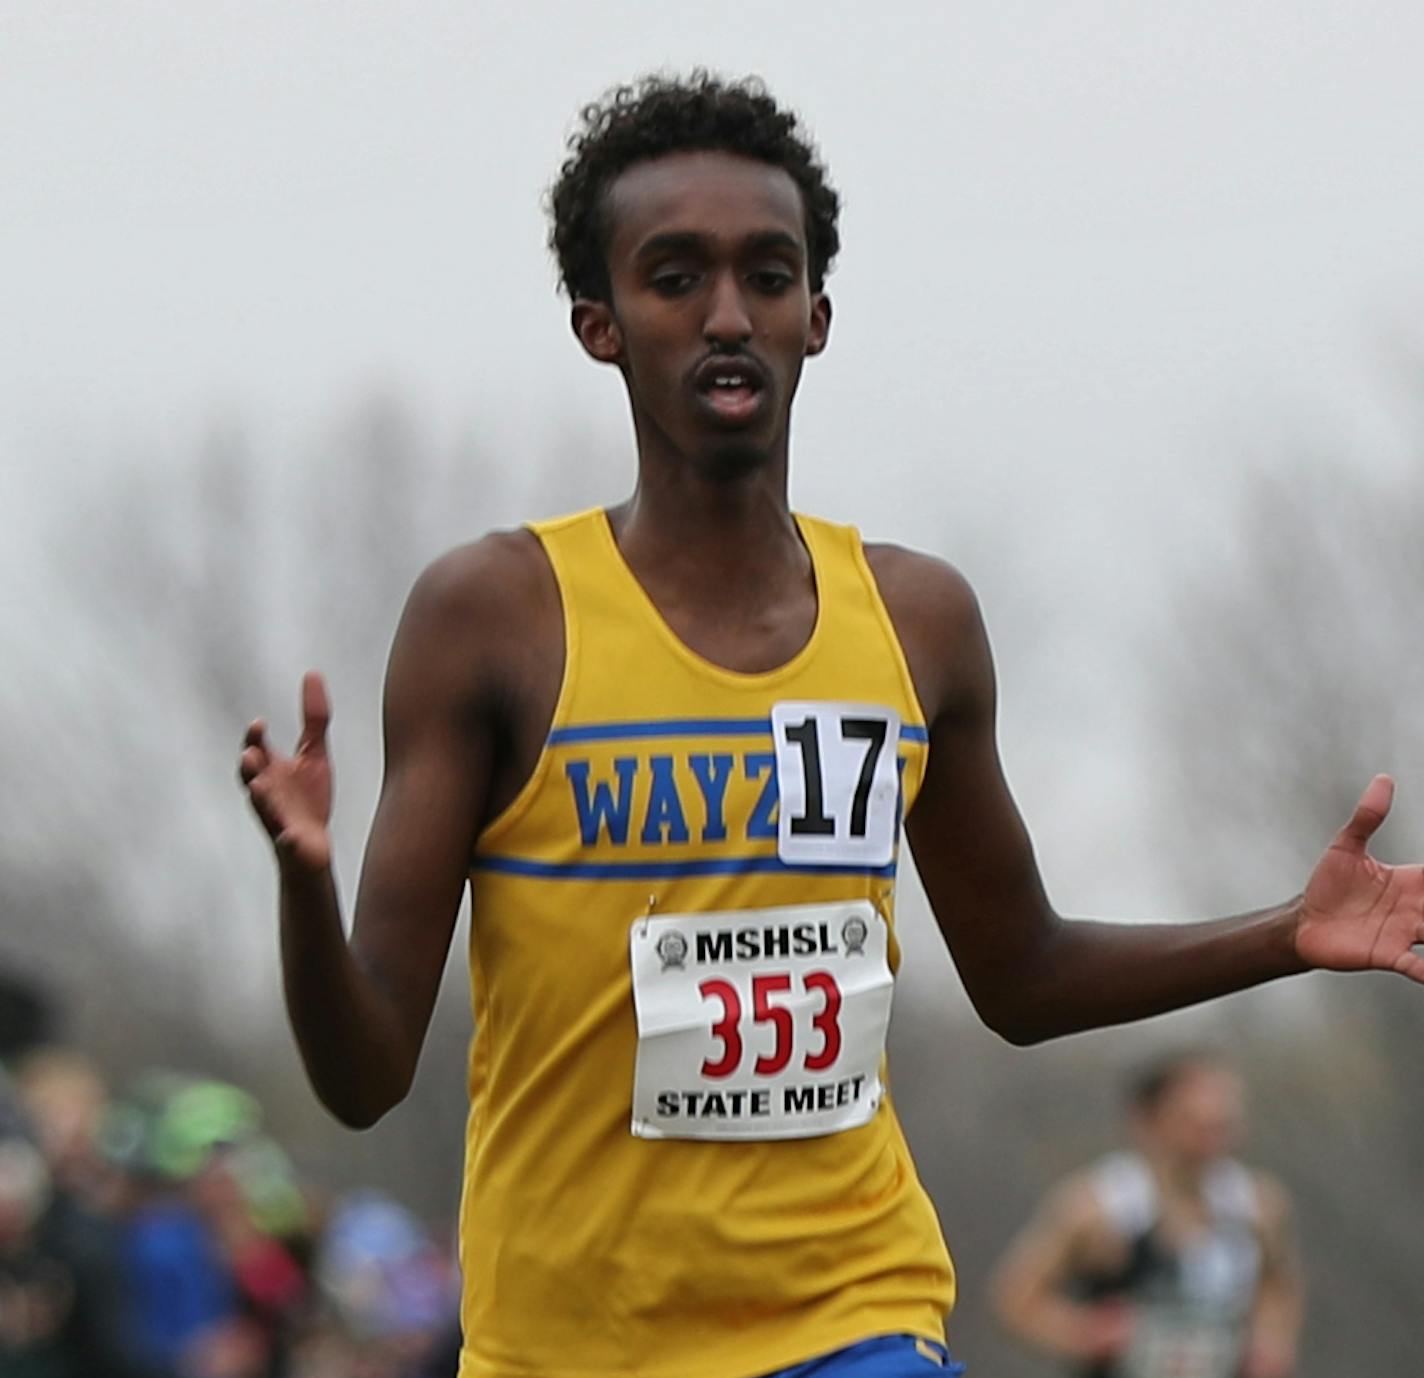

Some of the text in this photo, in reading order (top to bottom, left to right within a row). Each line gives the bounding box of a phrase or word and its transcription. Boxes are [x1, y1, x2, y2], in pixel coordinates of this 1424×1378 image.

[565, 753, 907, 847] WAYZ
[785, 715, 888, 837] 17
[696, 922, 838, 963] MSHSL
[699, 971, 842, 1081] 353
[656, 1075, 865, 1118] STATE MEET
